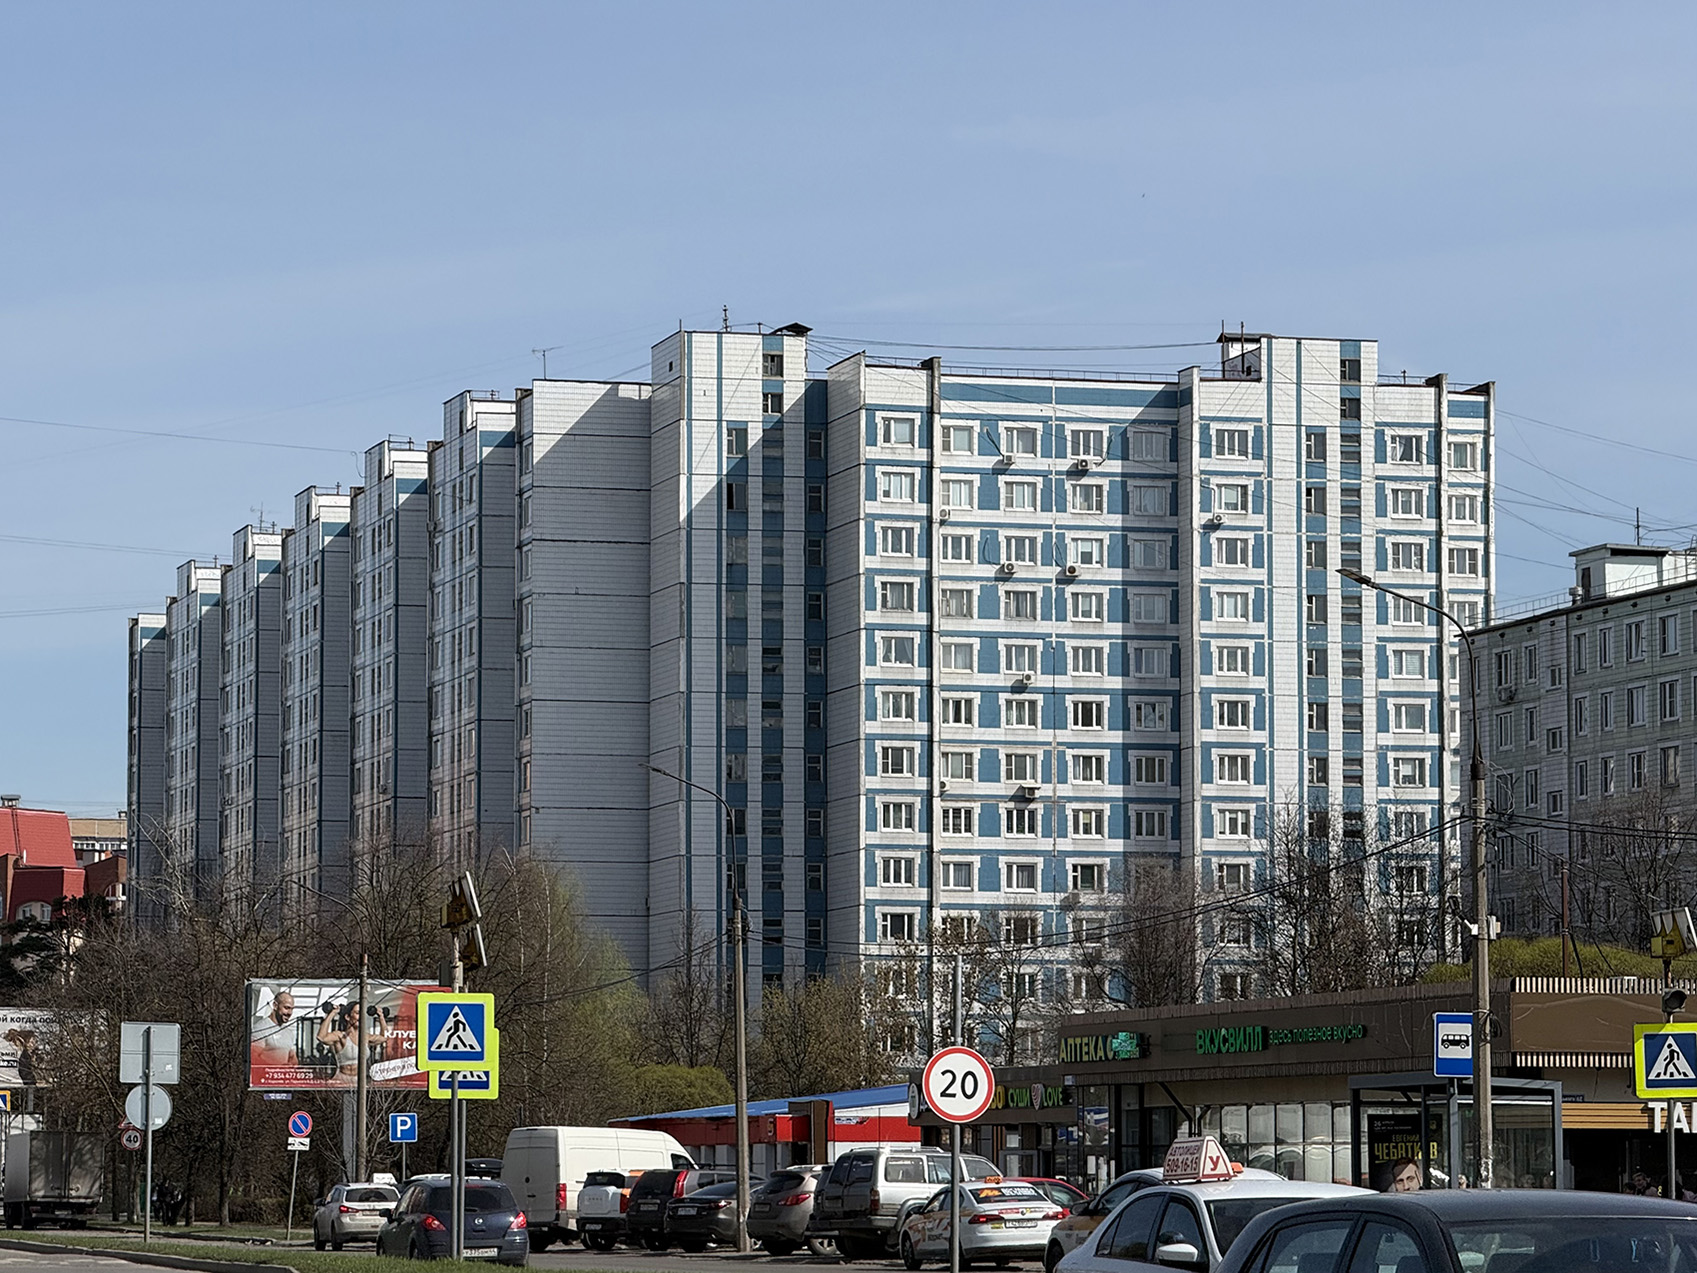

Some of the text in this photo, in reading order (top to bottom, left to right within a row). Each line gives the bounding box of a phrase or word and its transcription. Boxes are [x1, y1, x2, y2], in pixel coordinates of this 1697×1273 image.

[1196, 1026, 1262, 1054] ВКУСВИЛЛ
[1269, 1024, 1364, 1044] здесь полезное вкусно
[1060, 1035, 1105, 1062] АПТЕКА
[940, 1069, 978, 1100] 20
[1008, 1086, 1063, 1107] СУШИ LOVE
[397, 1116, 411, 1138] P
[126, 1135, 139, 1143] 40
[1374, 1142, 1438, 1160] ЧЕБАТКВ
[1208, 1156, 1221, 1171] У
